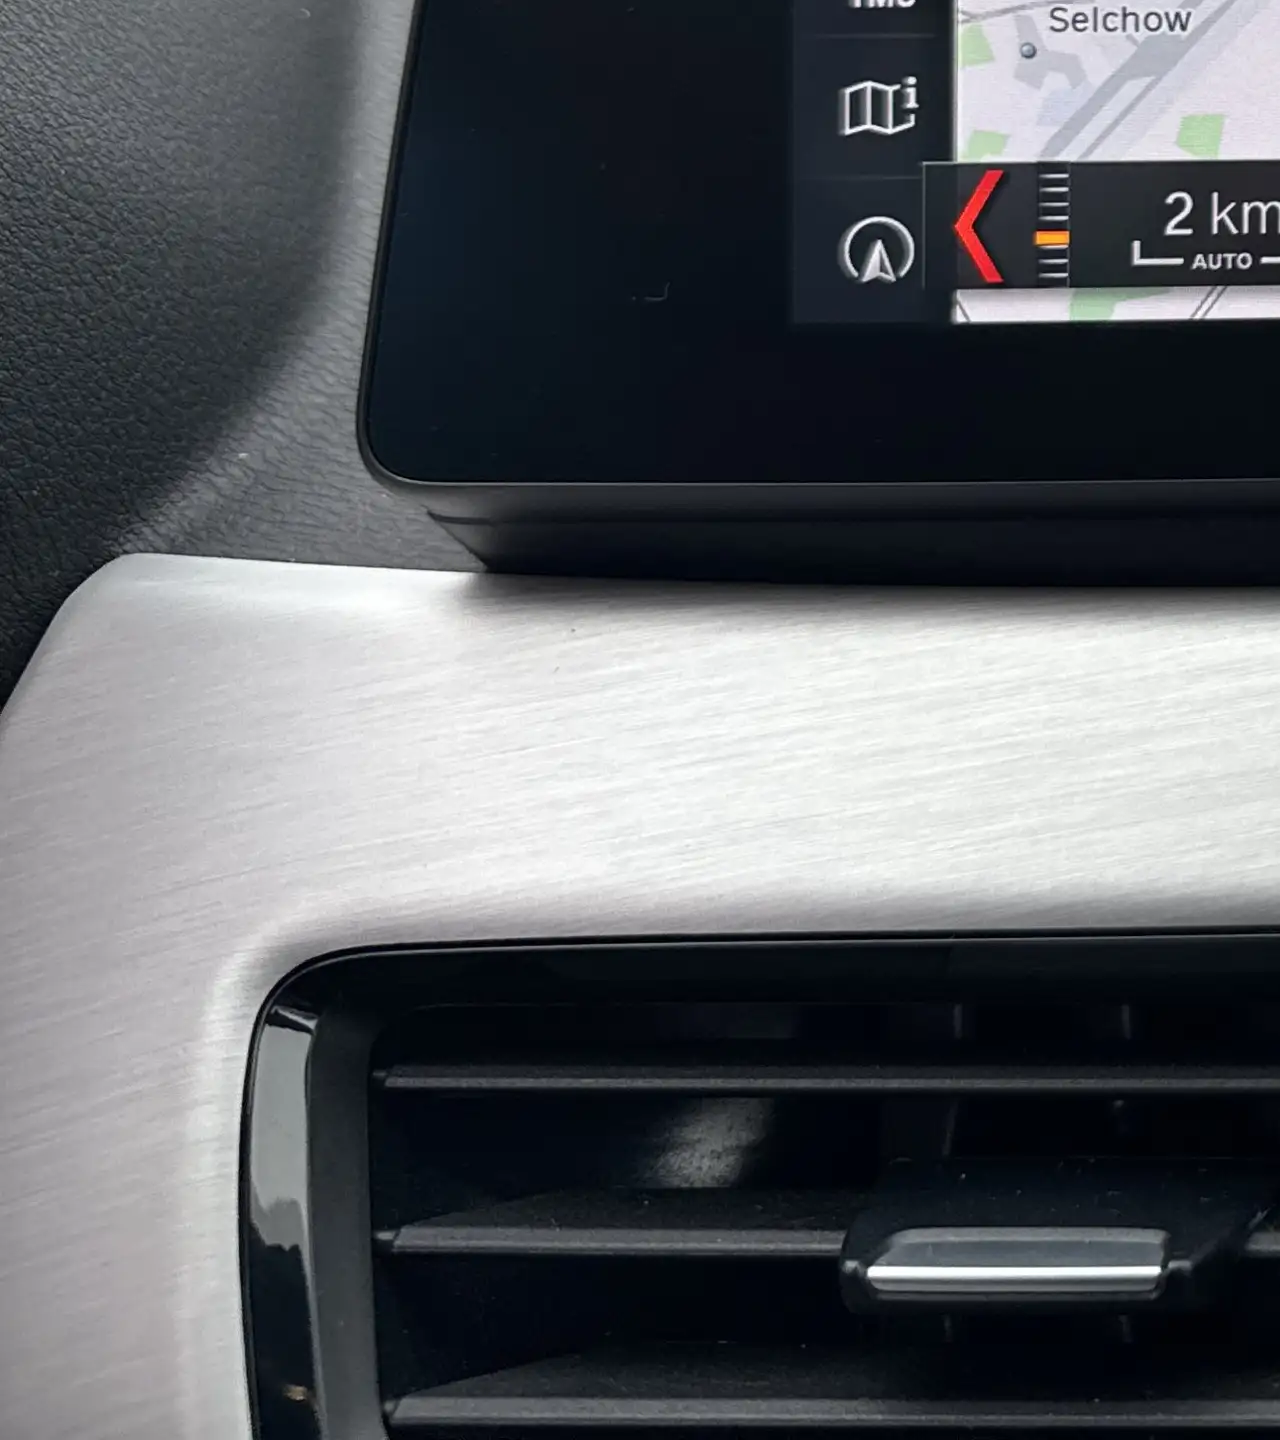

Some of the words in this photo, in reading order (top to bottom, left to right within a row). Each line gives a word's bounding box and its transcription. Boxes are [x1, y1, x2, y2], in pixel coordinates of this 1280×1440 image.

[1048, 5, 1192, 34] Selchow
[1163, 190, 1195, 236] 2
[1190, 253, 1253, 270] AUTO
